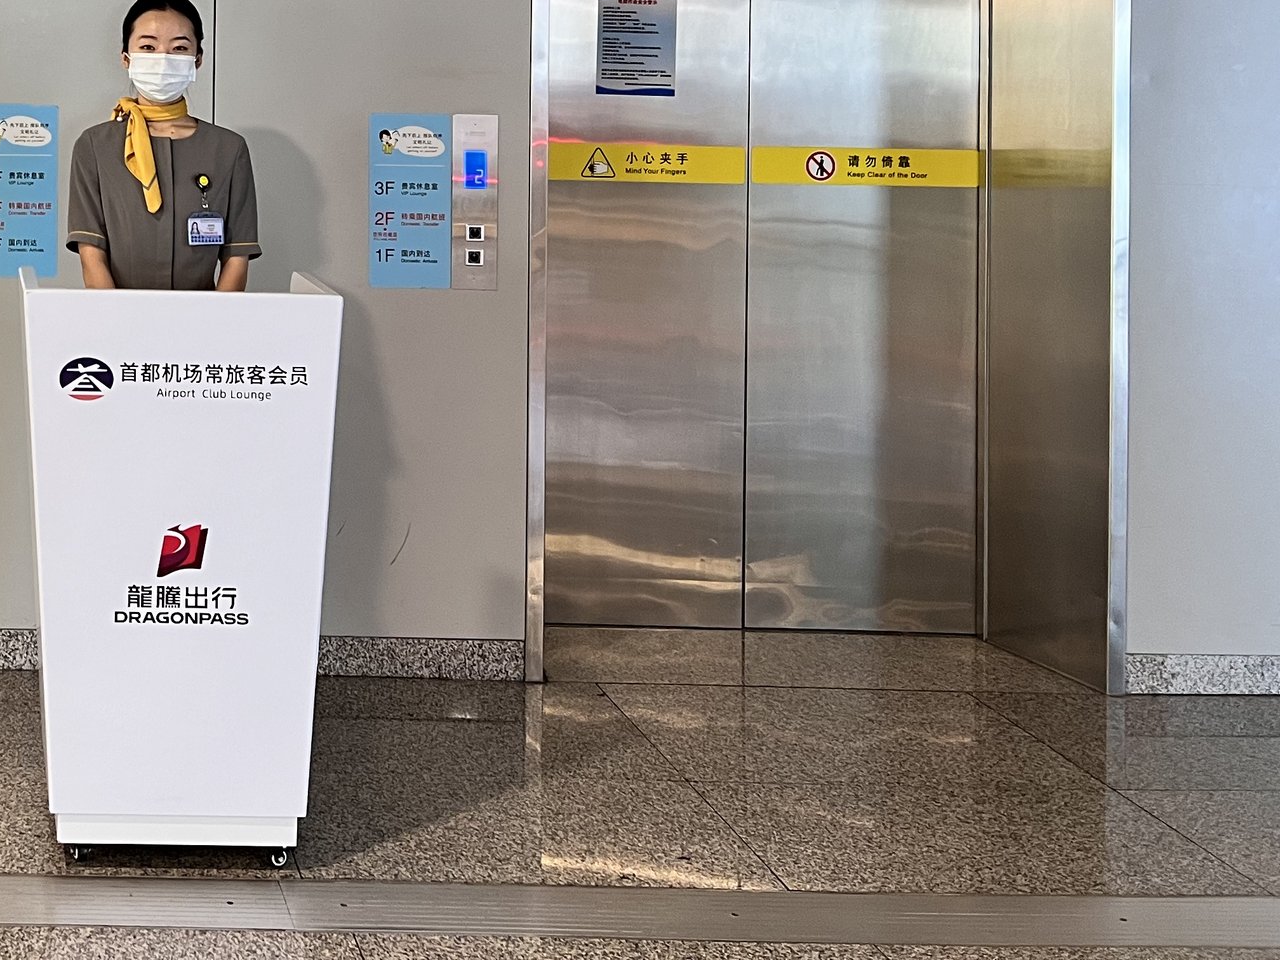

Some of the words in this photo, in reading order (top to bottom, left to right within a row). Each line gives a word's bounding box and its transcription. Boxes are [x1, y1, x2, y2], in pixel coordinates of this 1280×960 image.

[625, 151, 689, 166] 小心夹手
[847, 154, 911, 169] 请勿倚靠
[474, 169, 484, 184] 2
[660, 168, 687, 176] Fingers
[847, 171, 865, 179] Keep
[374, 181, 395, 196] 3F
[374, 211, 395, 226] 2F
[375, 248, 395, 263] 1F
[119, 362, 309, 386] 首都机场常旅客会员
[156, 388, 195, 400] Airport
[202, 389, 226, 399] Club
[230, 390, 272, 402] Lounge
[114, 611, 249, 625] DRAGONPASS
